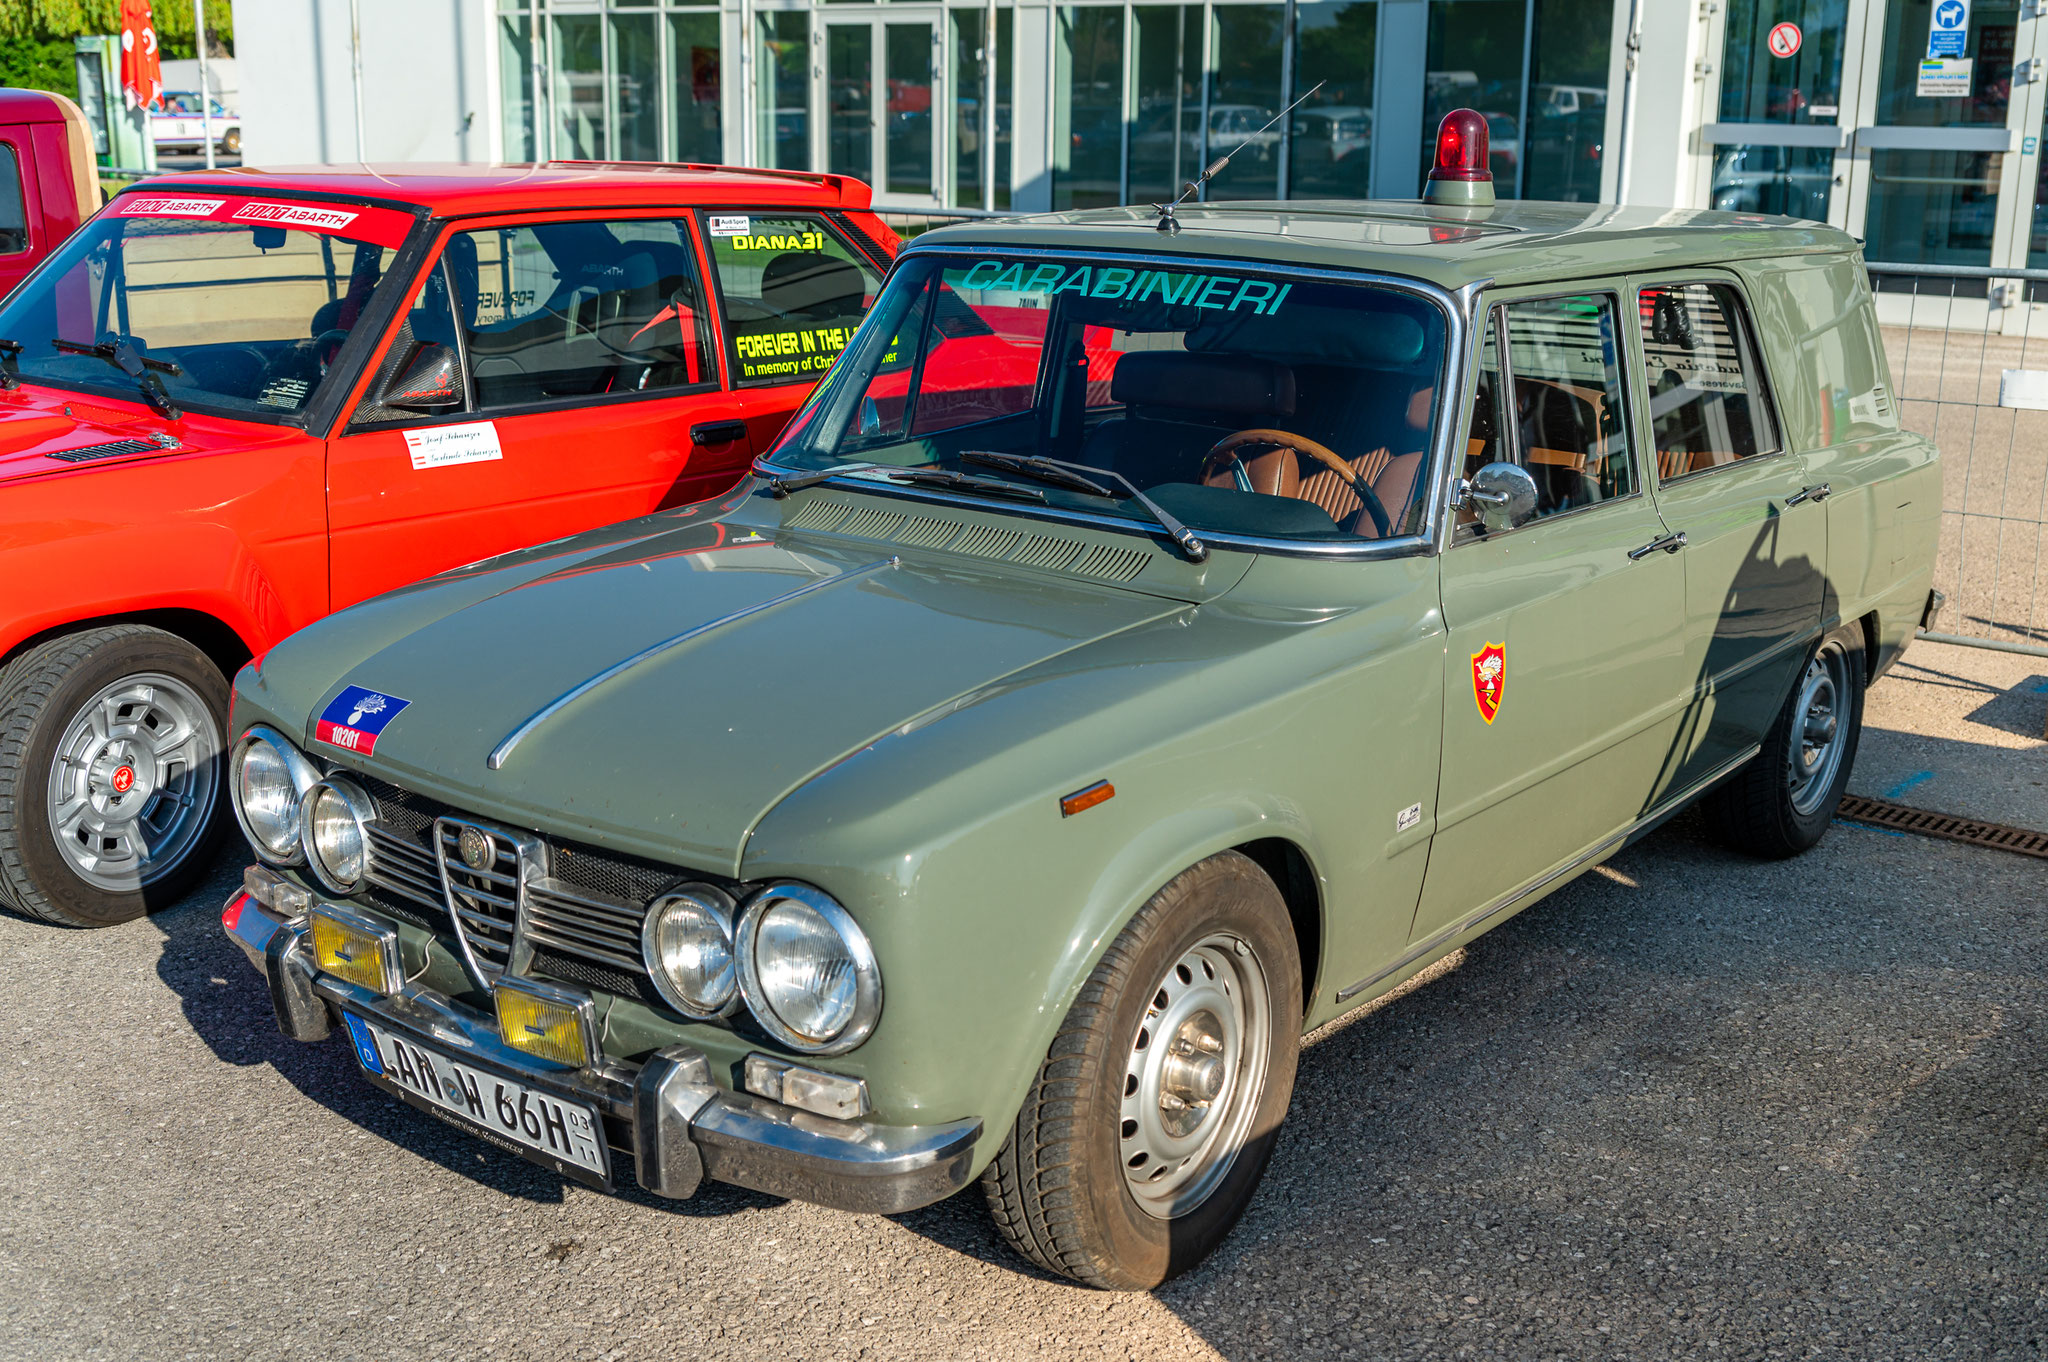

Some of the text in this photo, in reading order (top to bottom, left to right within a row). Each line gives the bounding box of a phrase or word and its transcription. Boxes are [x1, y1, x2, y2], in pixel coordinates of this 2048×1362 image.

[125, 200, 218, 213] FIAT ABARTH
[238, 204, 350, 226] FIAT ABARTH
[732, 232, 823, 250] DIANA31
[961, 260, 1293, 315] CARABINIERI
[736, 332, 800, 359] FOREVER
[800, 330, 816, 353] IN
[816, 327, 845, 351] THE
[743, 363, 755, 377] In
[757, 360, 799, 375] memory
[801, 357, 812, 370] of
[402, 389, 453, 398] ABARTH
[332, 725, 360, 749] 10201
[363, 1026, 575, 1156] D LAN W 66H
[570, 1111, 590, 1131] 03
